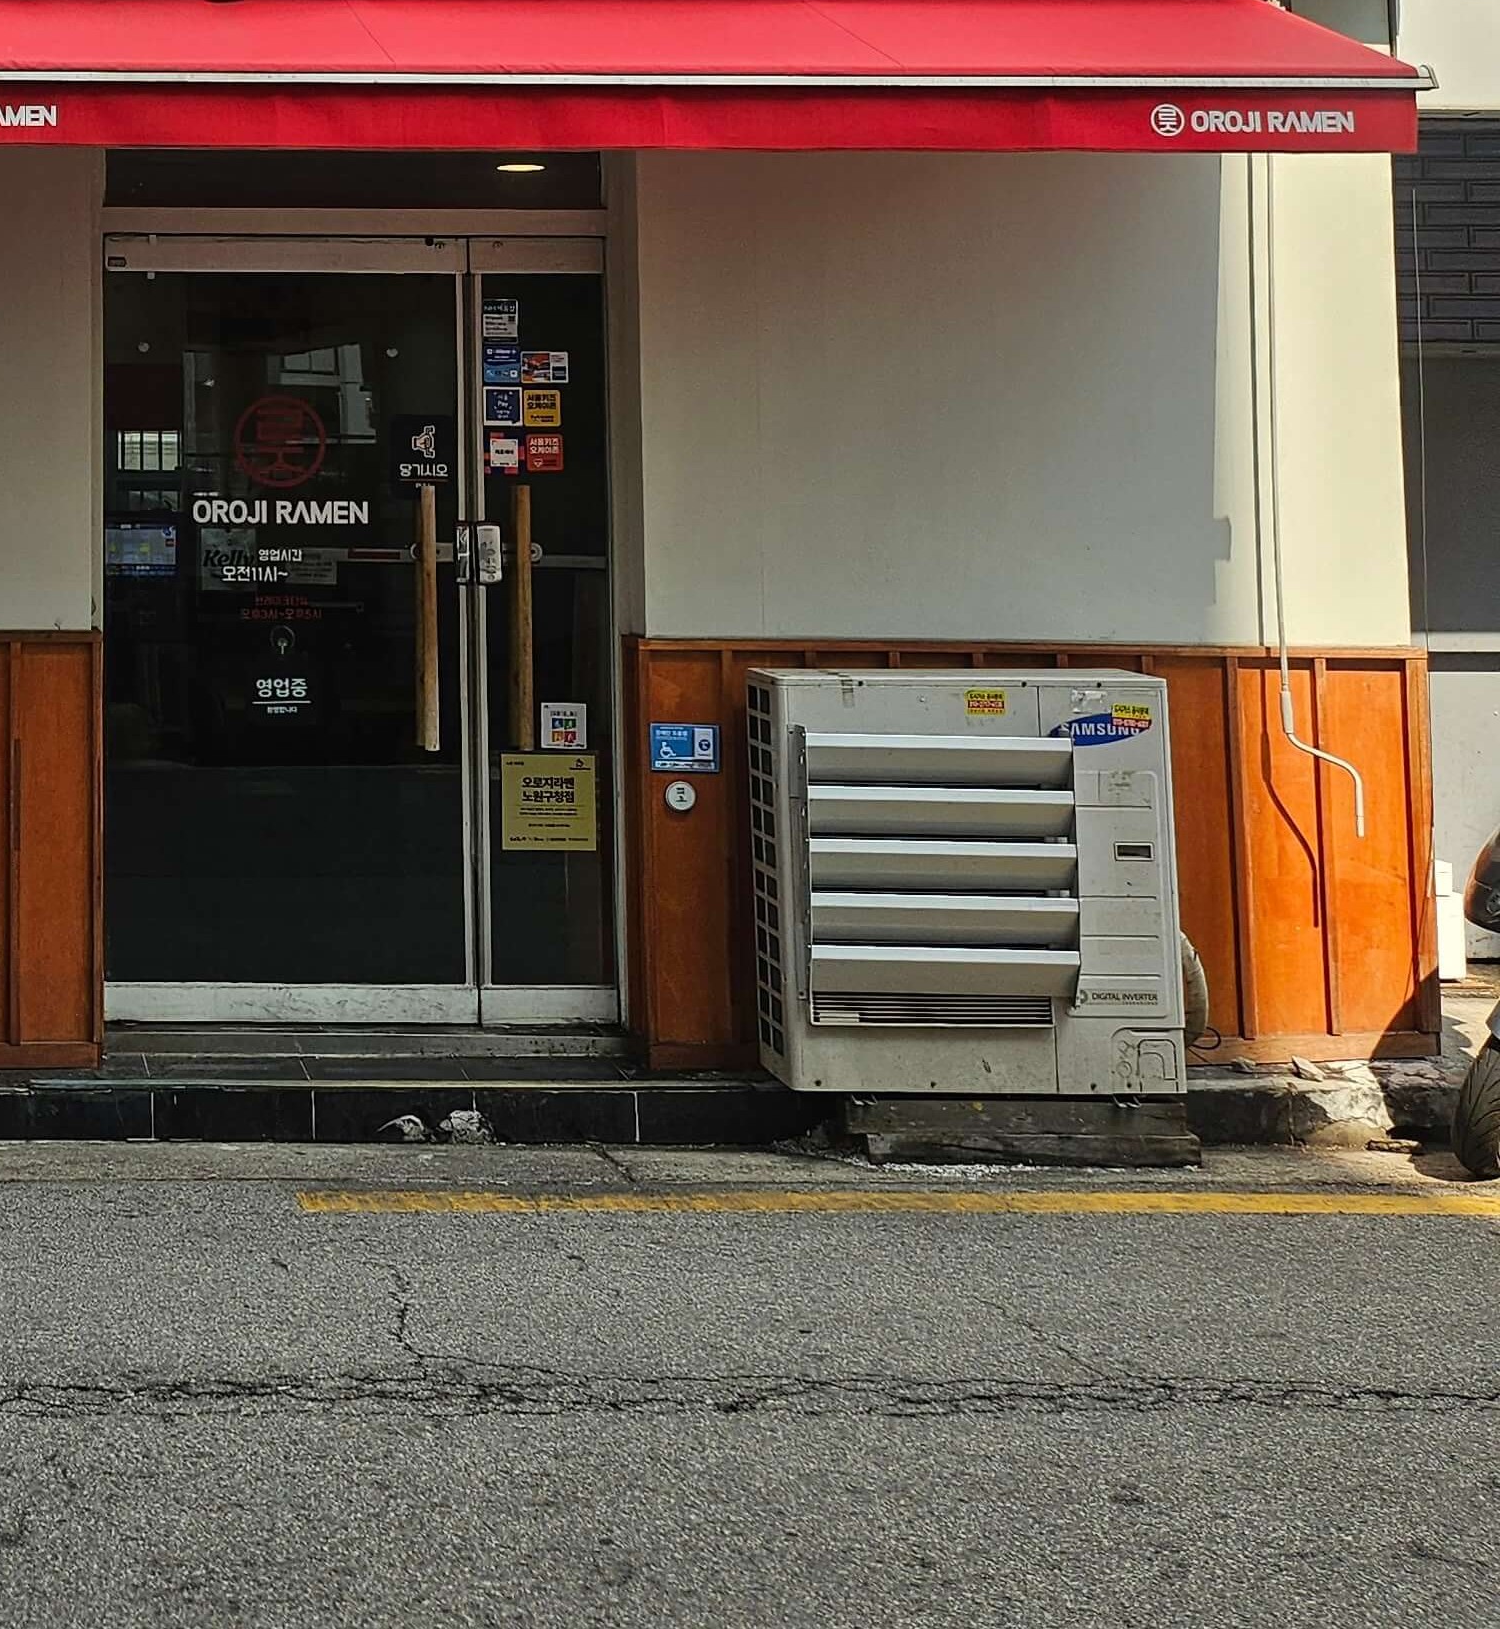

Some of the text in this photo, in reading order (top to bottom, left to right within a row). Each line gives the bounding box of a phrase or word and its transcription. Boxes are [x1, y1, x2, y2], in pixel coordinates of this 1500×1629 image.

[1190, 110, 1355, 134] OROJI RAMEN
[399, 463, 449, 477] 당기시오
[192, 499, 369, 525] OROJI RAMEN
[258, 548, 303, 562] 영업시간
[255, 677, 308, 698] 영업중
[1091, 992, 1158, 1001] DIGITAL INVERTER
